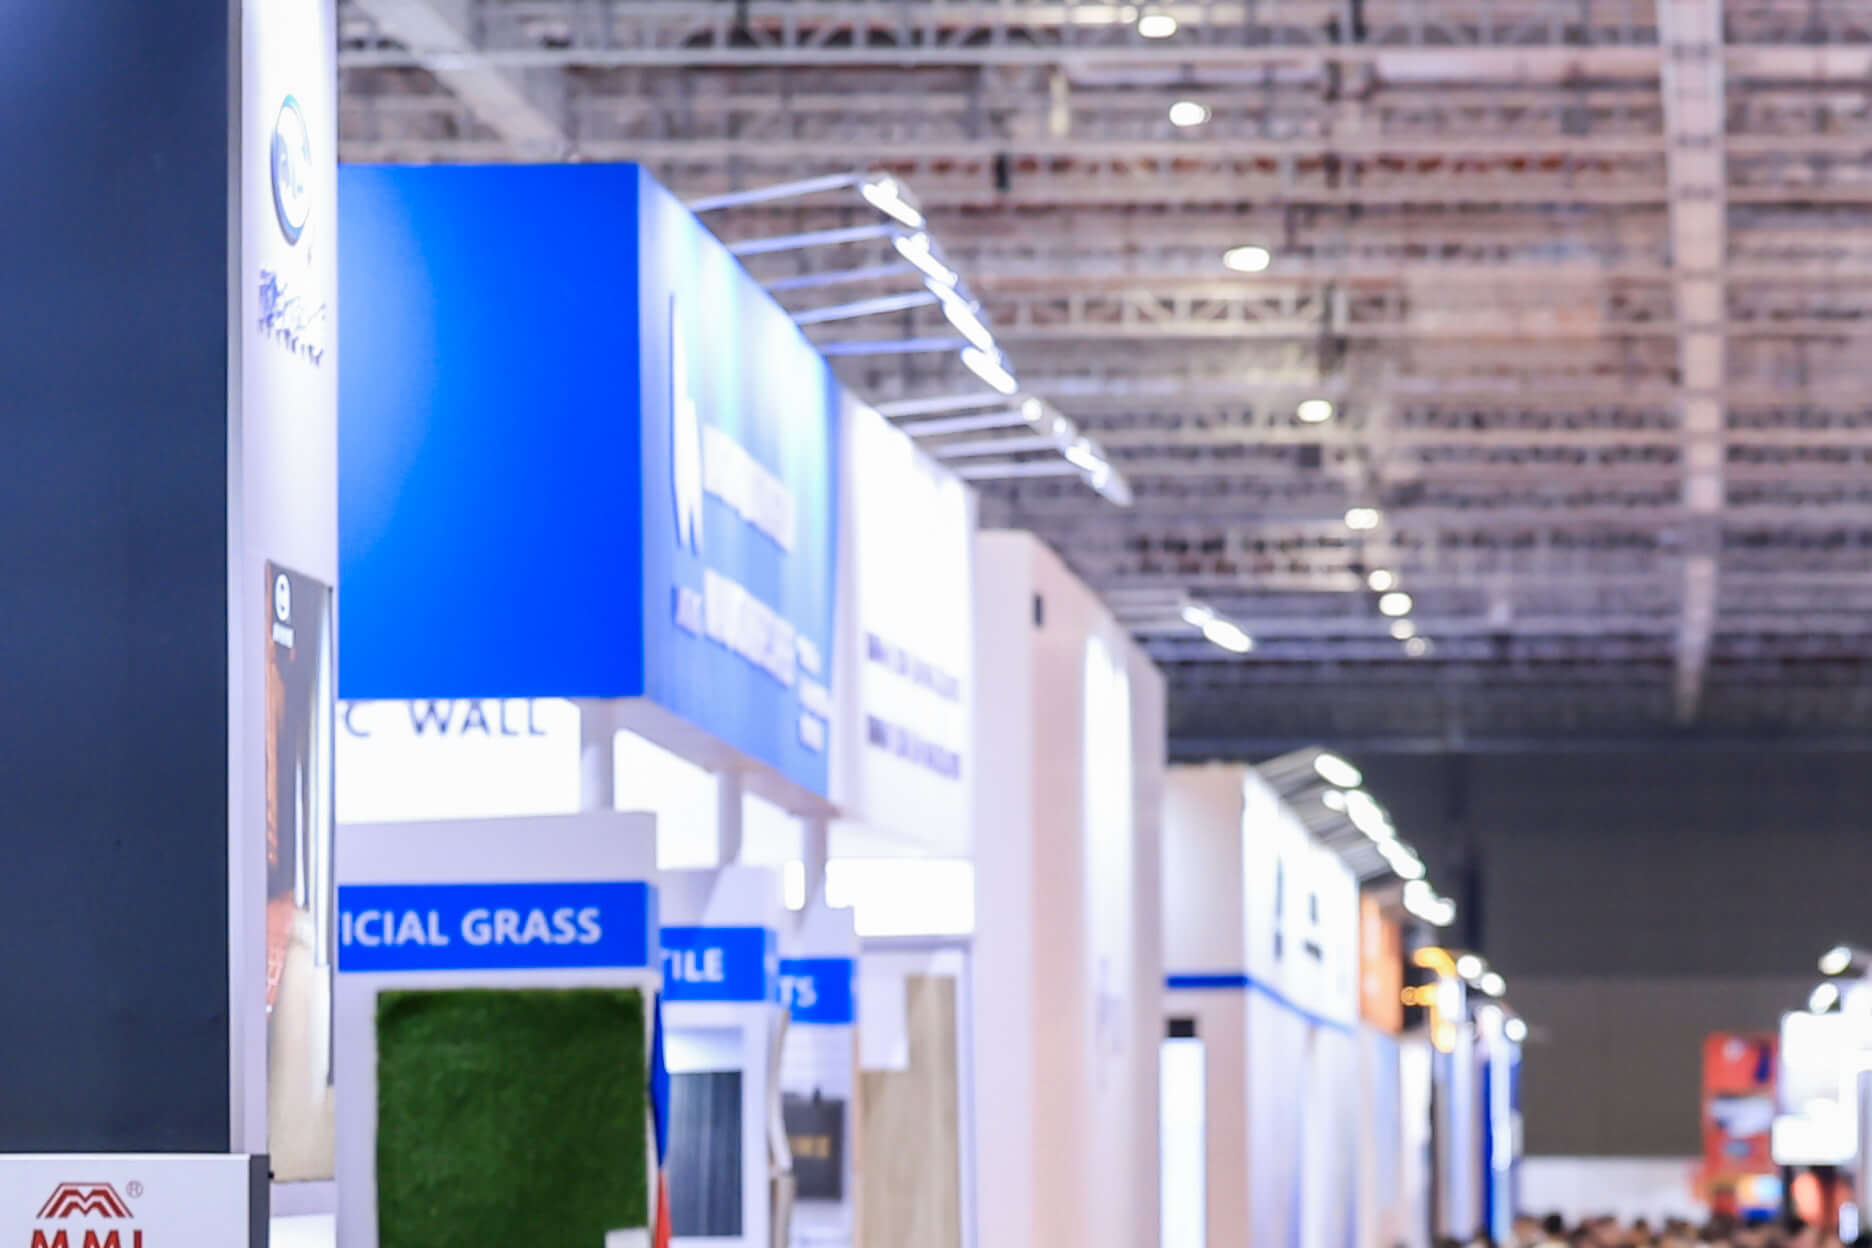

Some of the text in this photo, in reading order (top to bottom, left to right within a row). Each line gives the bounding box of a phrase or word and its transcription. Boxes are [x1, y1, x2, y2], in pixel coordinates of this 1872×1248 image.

[408, 699, 548, 737] WALL
[341, 907, 603, 947] ICIAL GRASS
